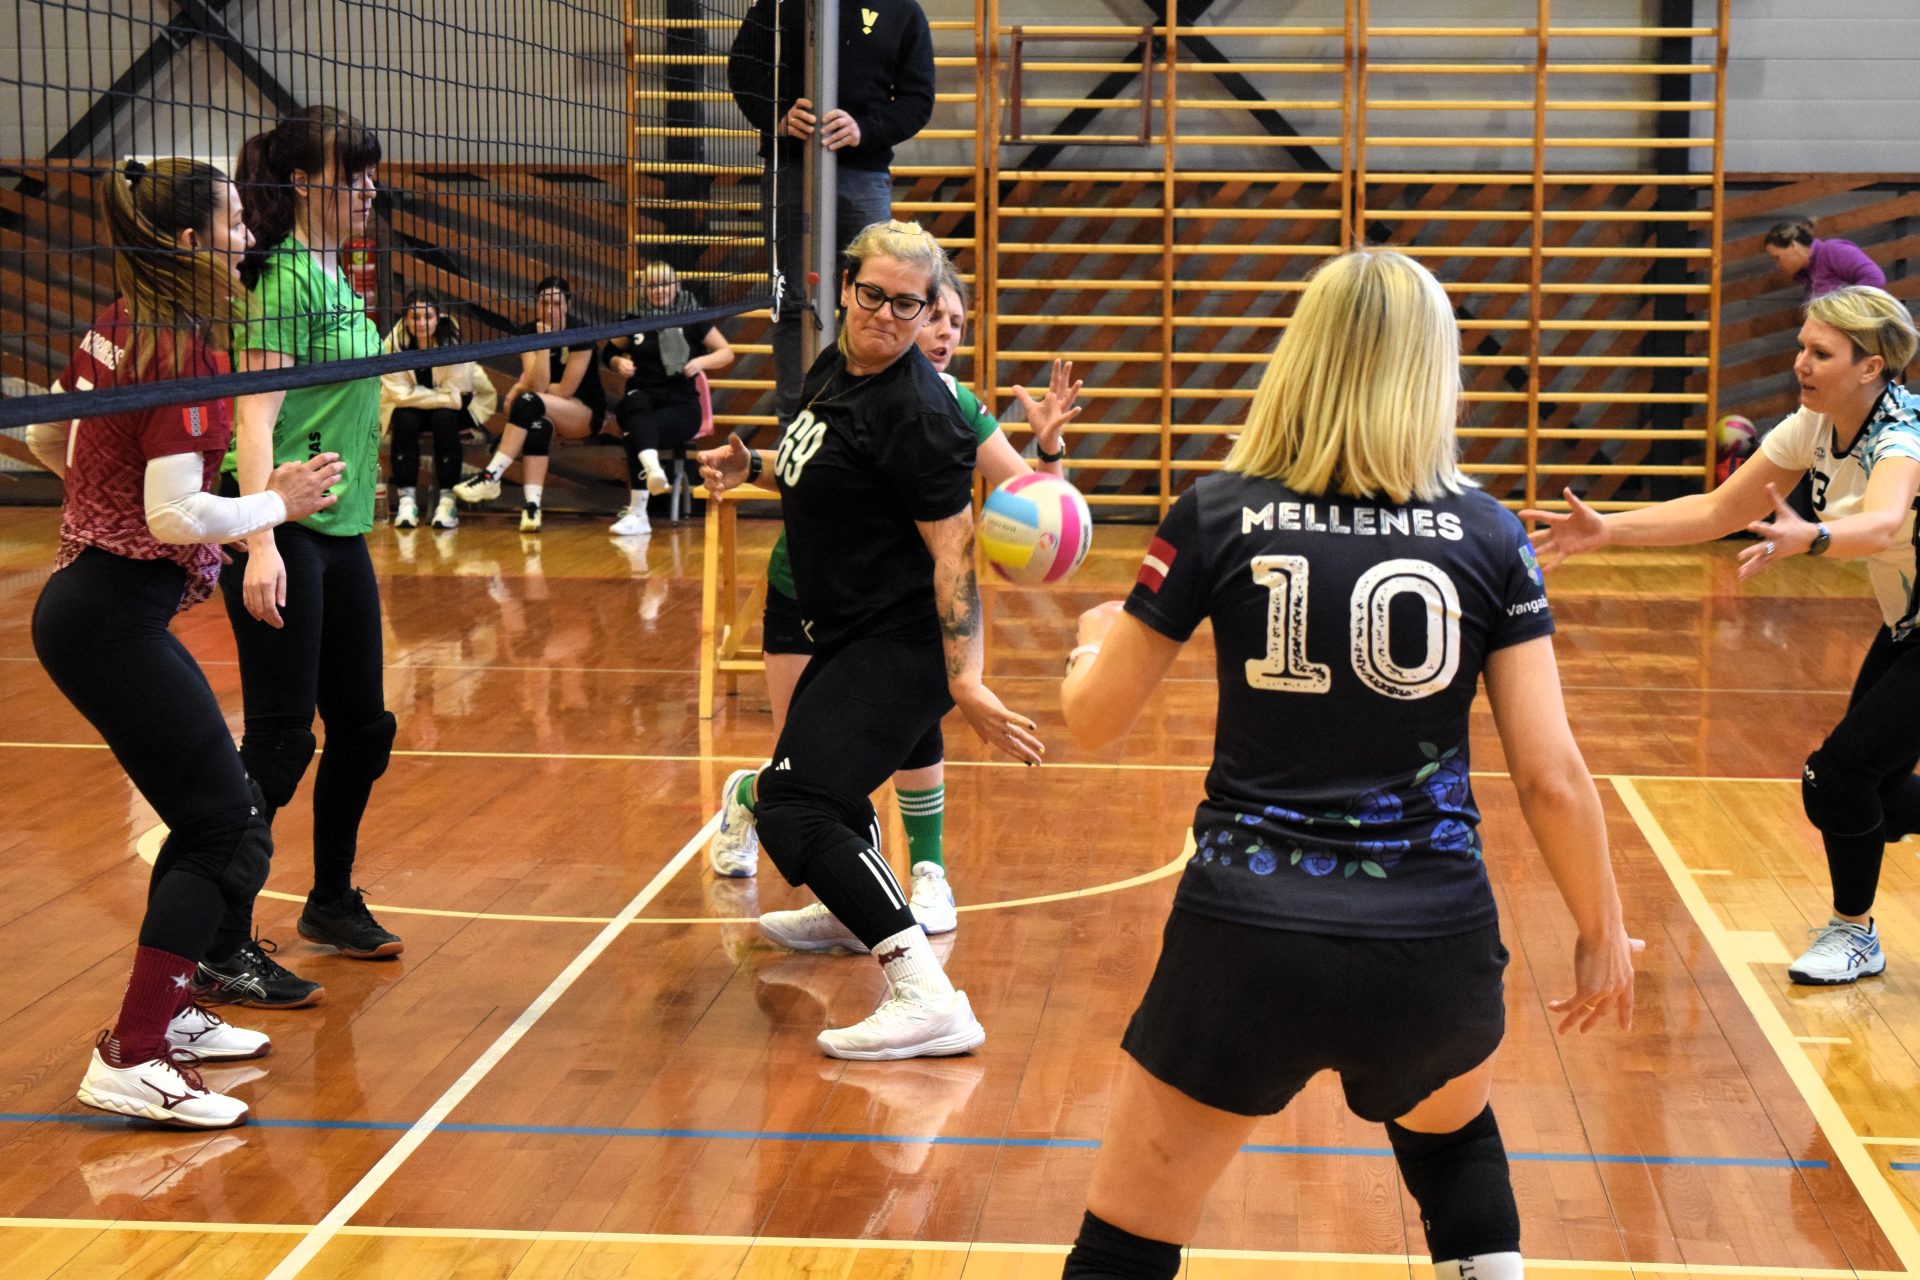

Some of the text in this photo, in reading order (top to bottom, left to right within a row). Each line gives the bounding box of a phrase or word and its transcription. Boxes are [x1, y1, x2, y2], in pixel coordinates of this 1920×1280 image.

[774, 409, 828, 487] 69
[1241, 502, 1464, 541] MELLENES
[1244, 555, 1462, 700] 10
